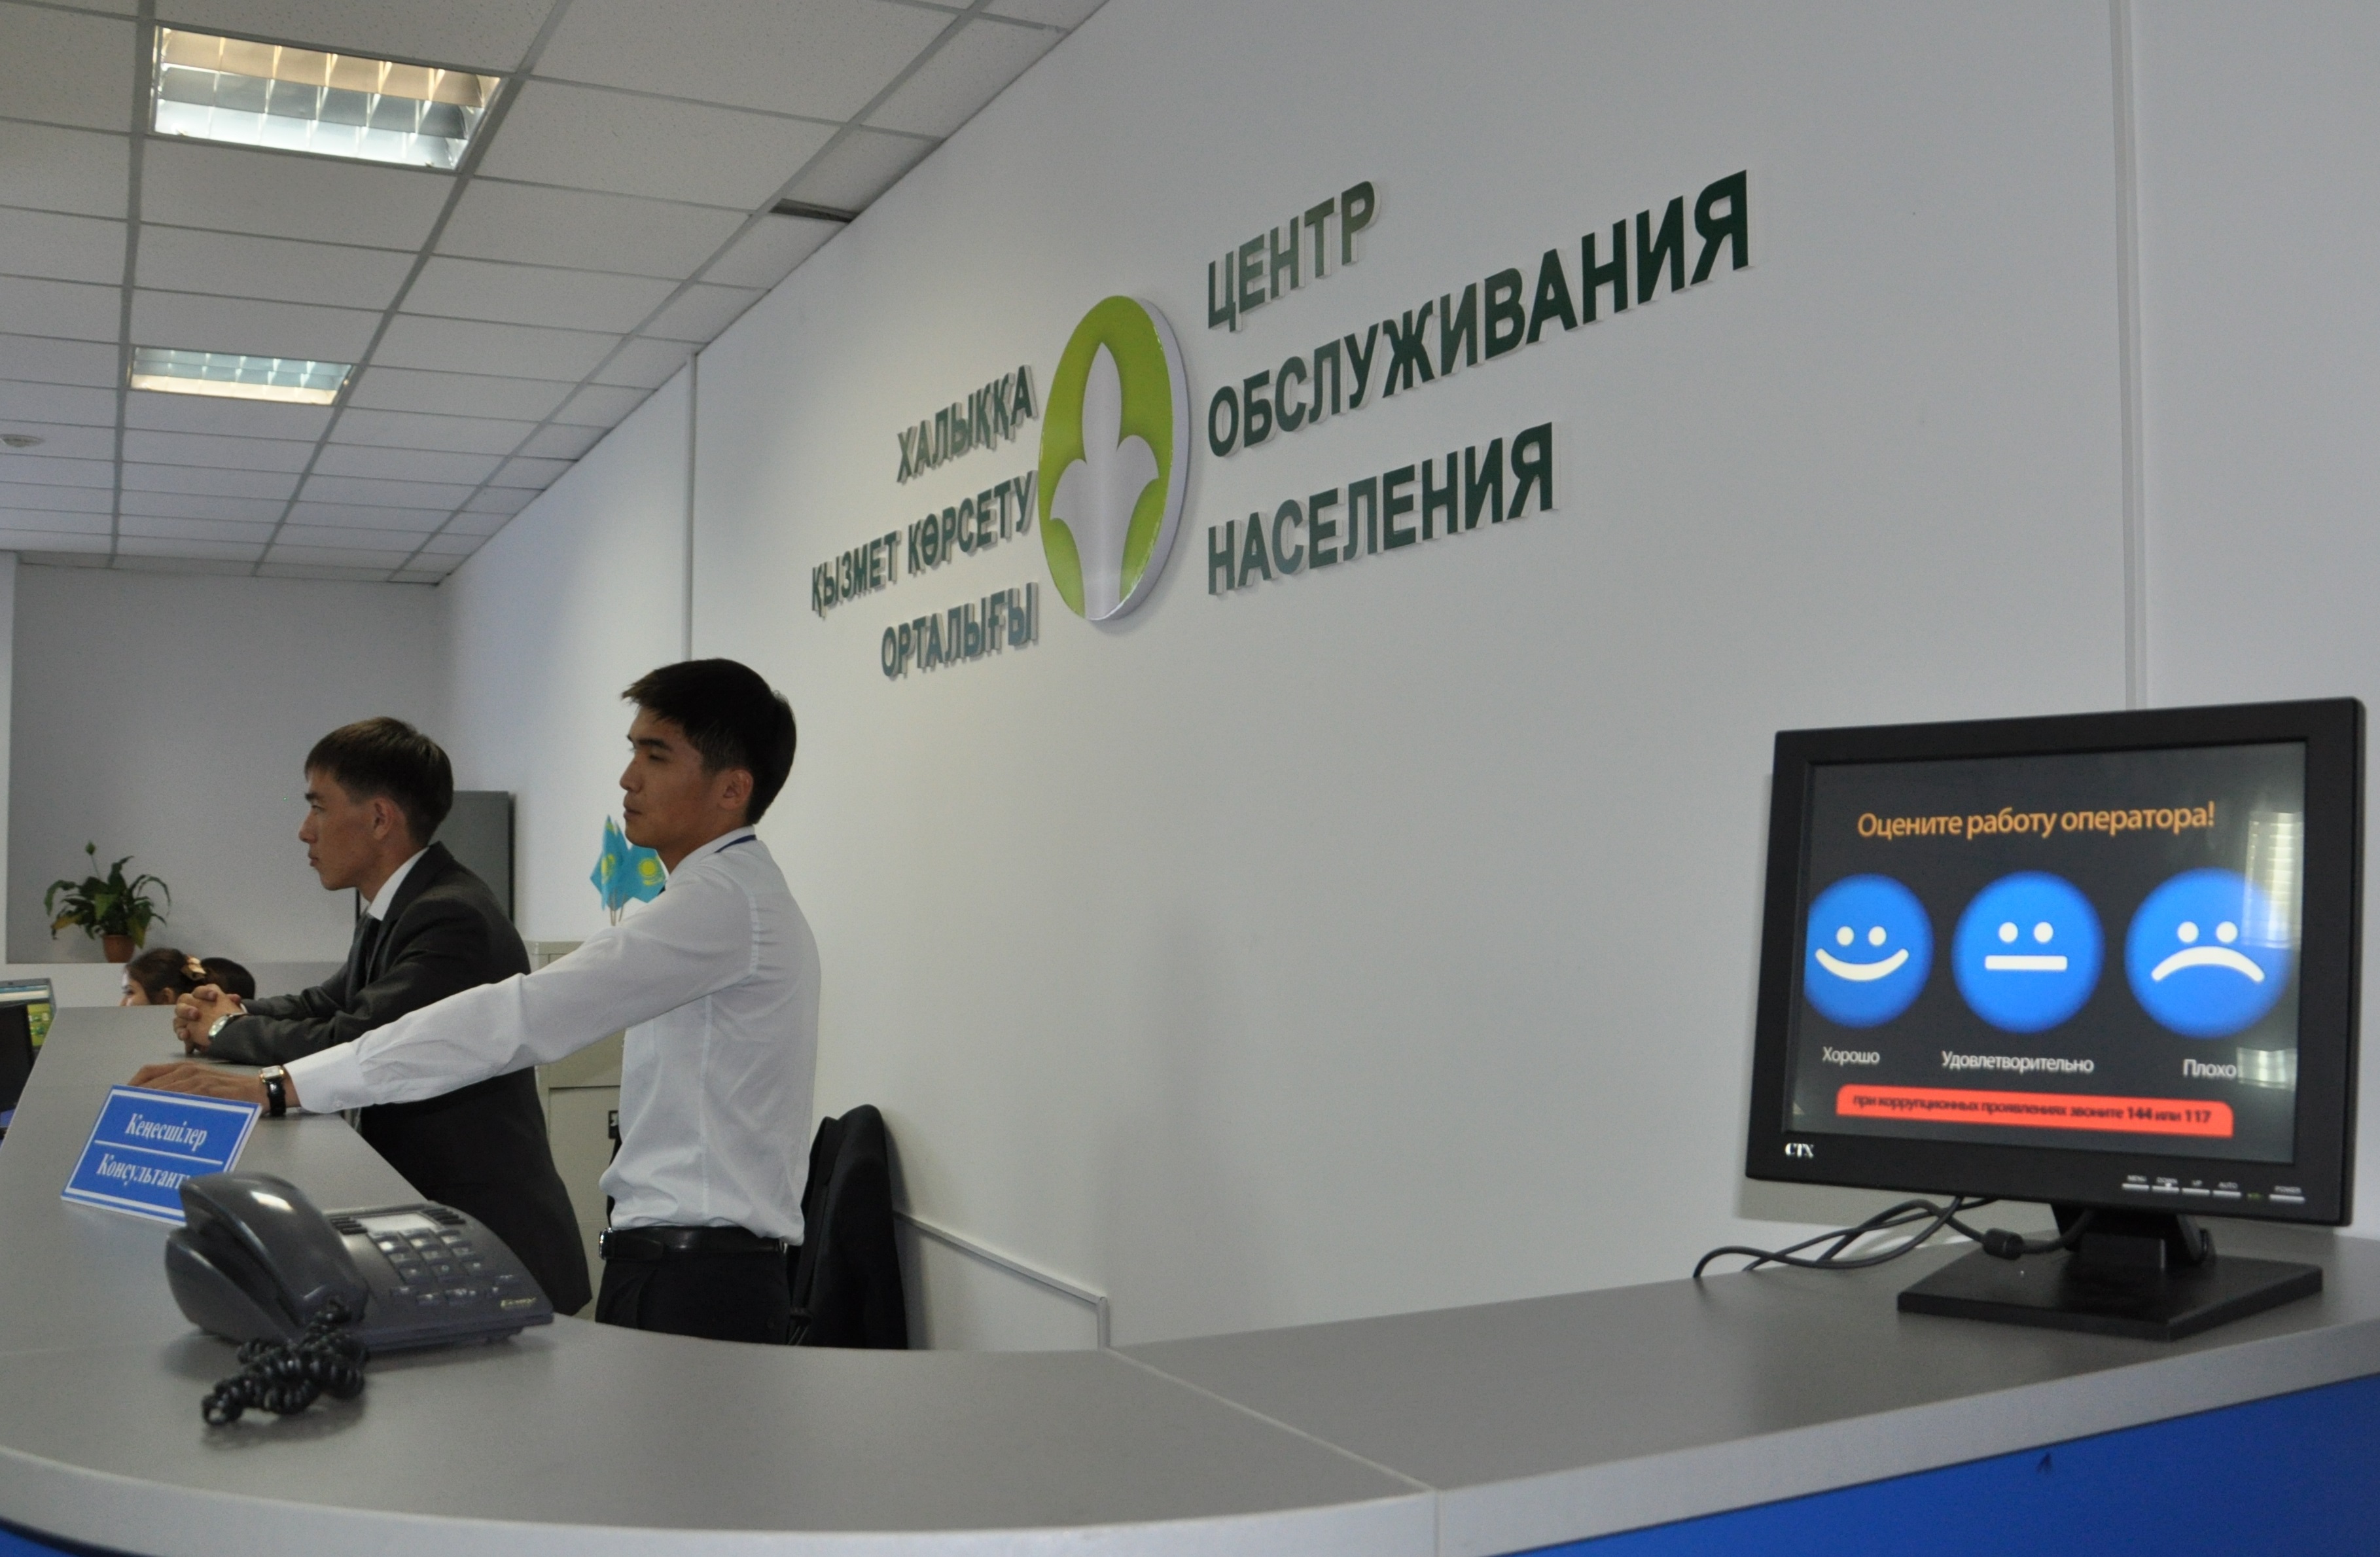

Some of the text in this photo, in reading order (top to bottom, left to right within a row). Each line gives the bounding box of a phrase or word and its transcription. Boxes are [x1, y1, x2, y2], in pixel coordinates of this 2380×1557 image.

[1208, 181, 1379, 332] ЦЕНТР
[1208, 170, 1750, 457] ОБСЛУЖИВАНИЯ
[897, 365, 1037, 482] ХАЛЫҚҚА
[1208, 422, 1556, 595] НАСЕЛЕНИЯ
[812, 470, 1037, 618] ҚЫЗМЕТ КӨРСЕТУ
[881, 582, 1037, 677] ОРТАЛЫҒЫ
[1858, 801, 2214, 840] Оцените работу оператора!
[1822, 1047, 2237, 1078] Хорошо Удовлетворительно Плохо
[125, 1113, 207, 1152] Кеңесшілер
[2127, 1107, 2152, 1120] 144
[2186, 1110, 2212, 1123] 117
[96, 1153, 191, 1190] Консультант
[1785, 1143, 1814, 1159] CTX
